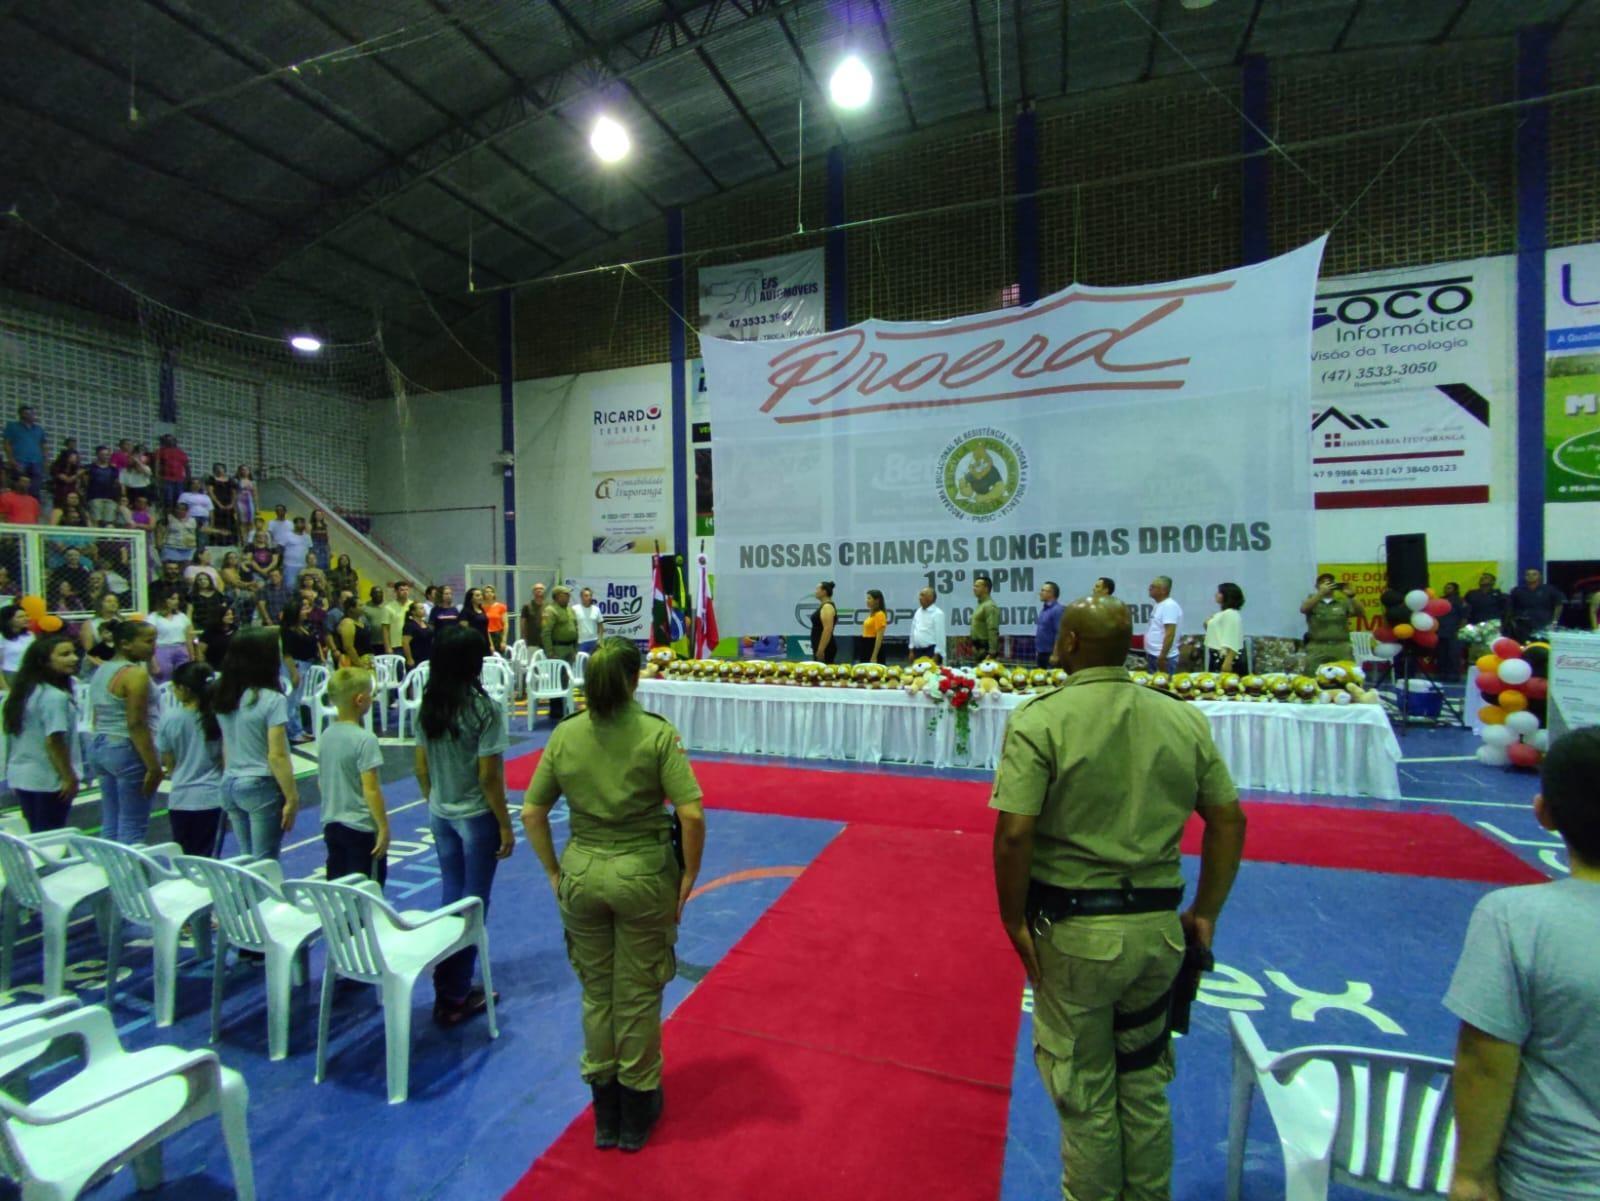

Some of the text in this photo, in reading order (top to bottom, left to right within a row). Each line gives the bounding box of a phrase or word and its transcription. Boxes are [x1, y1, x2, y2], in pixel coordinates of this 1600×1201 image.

[1337, 318, 1473, 343] Informática
[1356, 346, 1376, 357] da
[1382, 337, 1468, 353] Tecnologia
[1321, 361, 1437, 383] (47) 3533-3050
[739, 521, 1272, 570] NOSSAS CRIANÇAS LONGE DAS DROGAS
[607, 582, 638, 600] Agro
